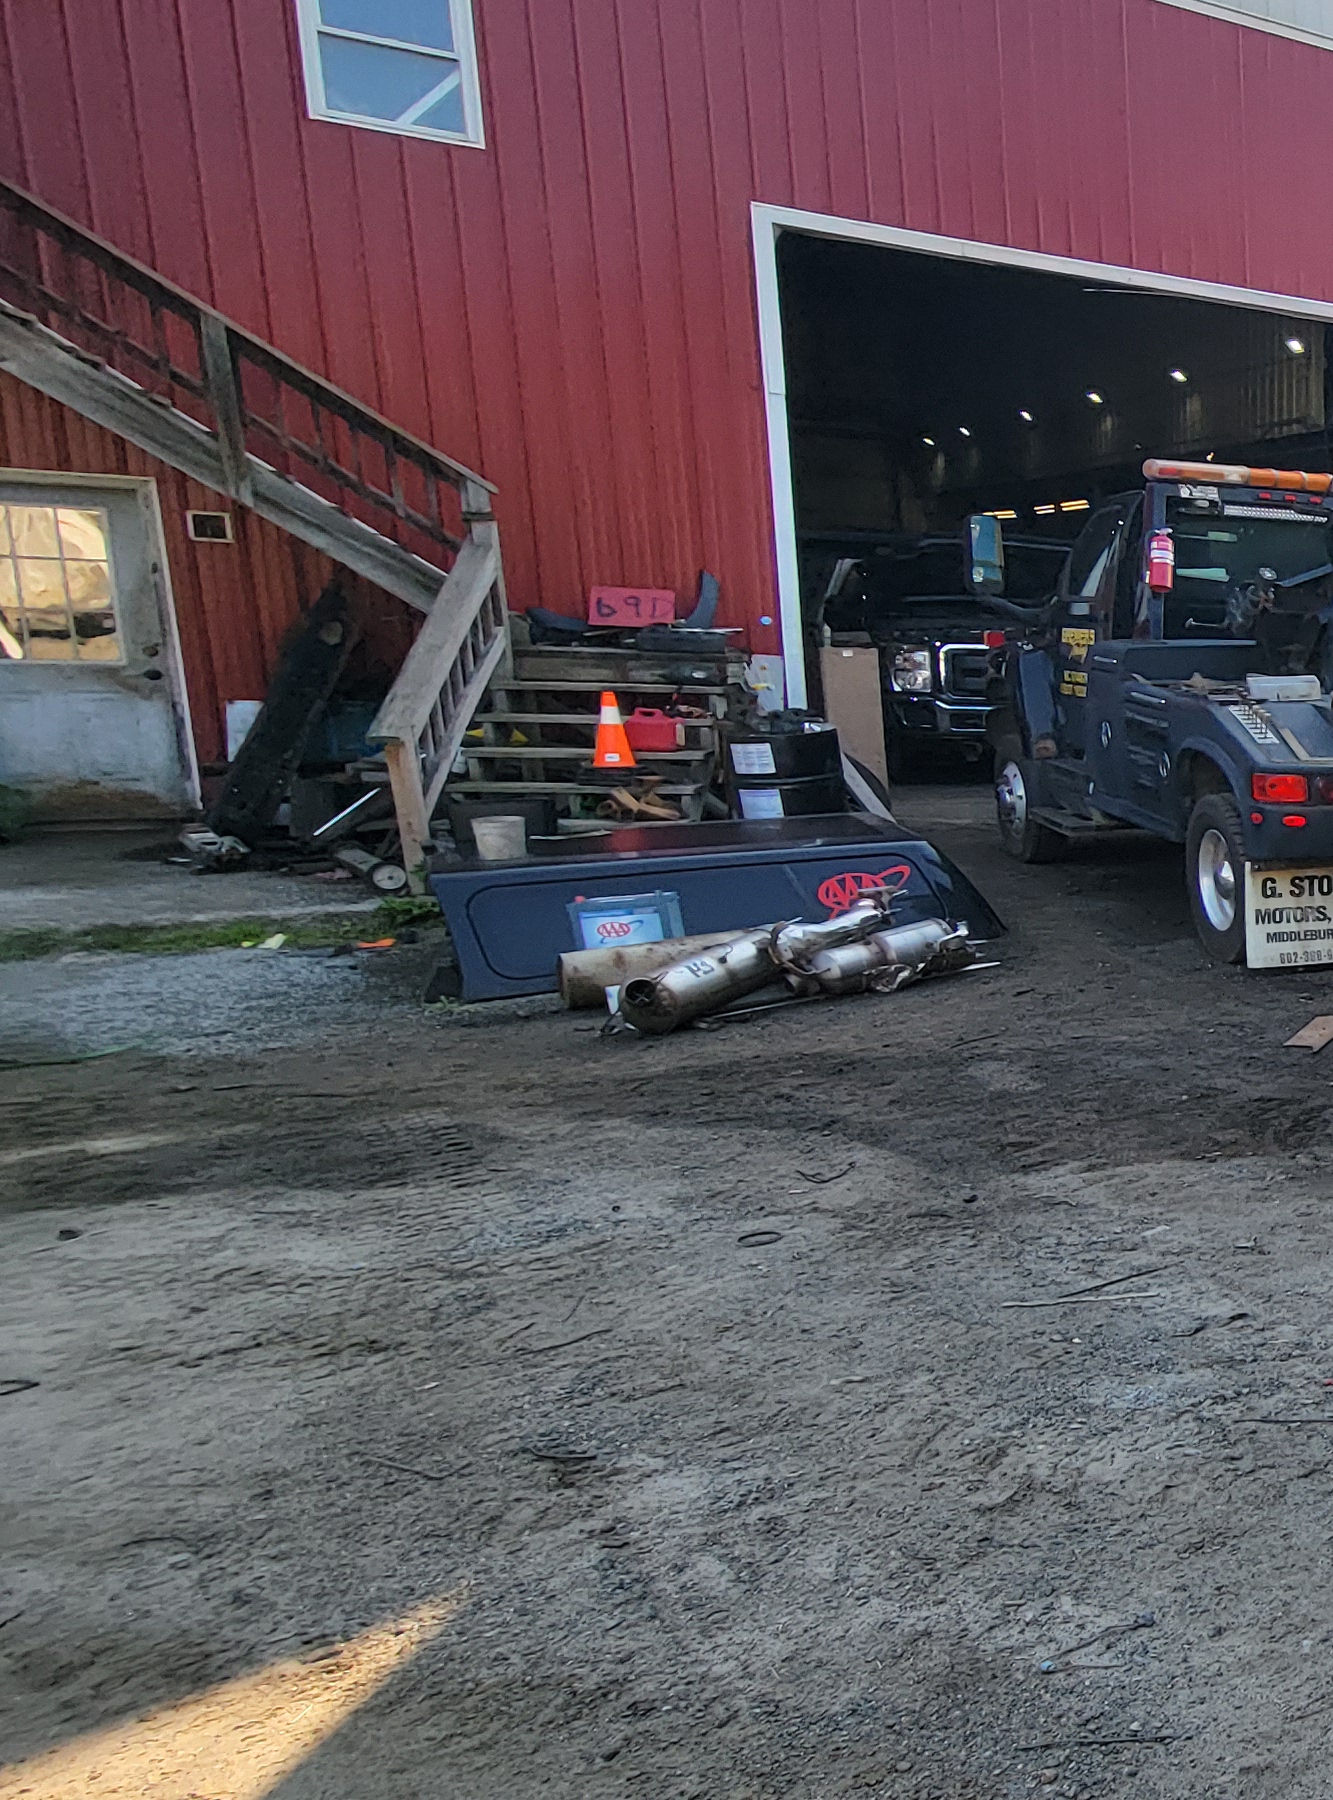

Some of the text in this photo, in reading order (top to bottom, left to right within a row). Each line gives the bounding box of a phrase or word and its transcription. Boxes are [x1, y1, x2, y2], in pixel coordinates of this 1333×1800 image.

[1262, 877, 1282, 898] G.
[1255, 905, 1331, 924] MOTORS,
[597, 922, 632, 938] AAA
